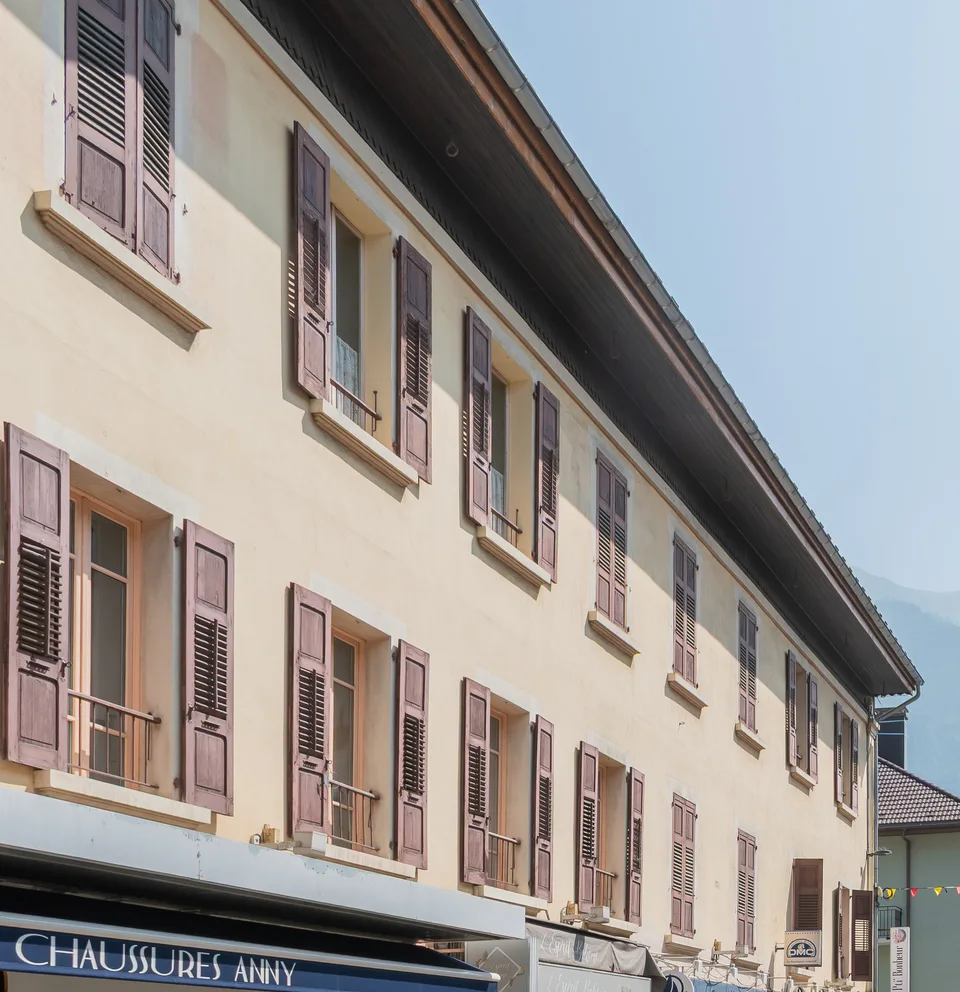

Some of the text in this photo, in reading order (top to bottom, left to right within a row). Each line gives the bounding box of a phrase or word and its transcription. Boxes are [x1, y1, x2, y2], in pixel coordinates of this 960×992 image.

[15, 933, 297, 987] CHAUSSURES ANNY
[892, 946, 903, 977] Bonheur
